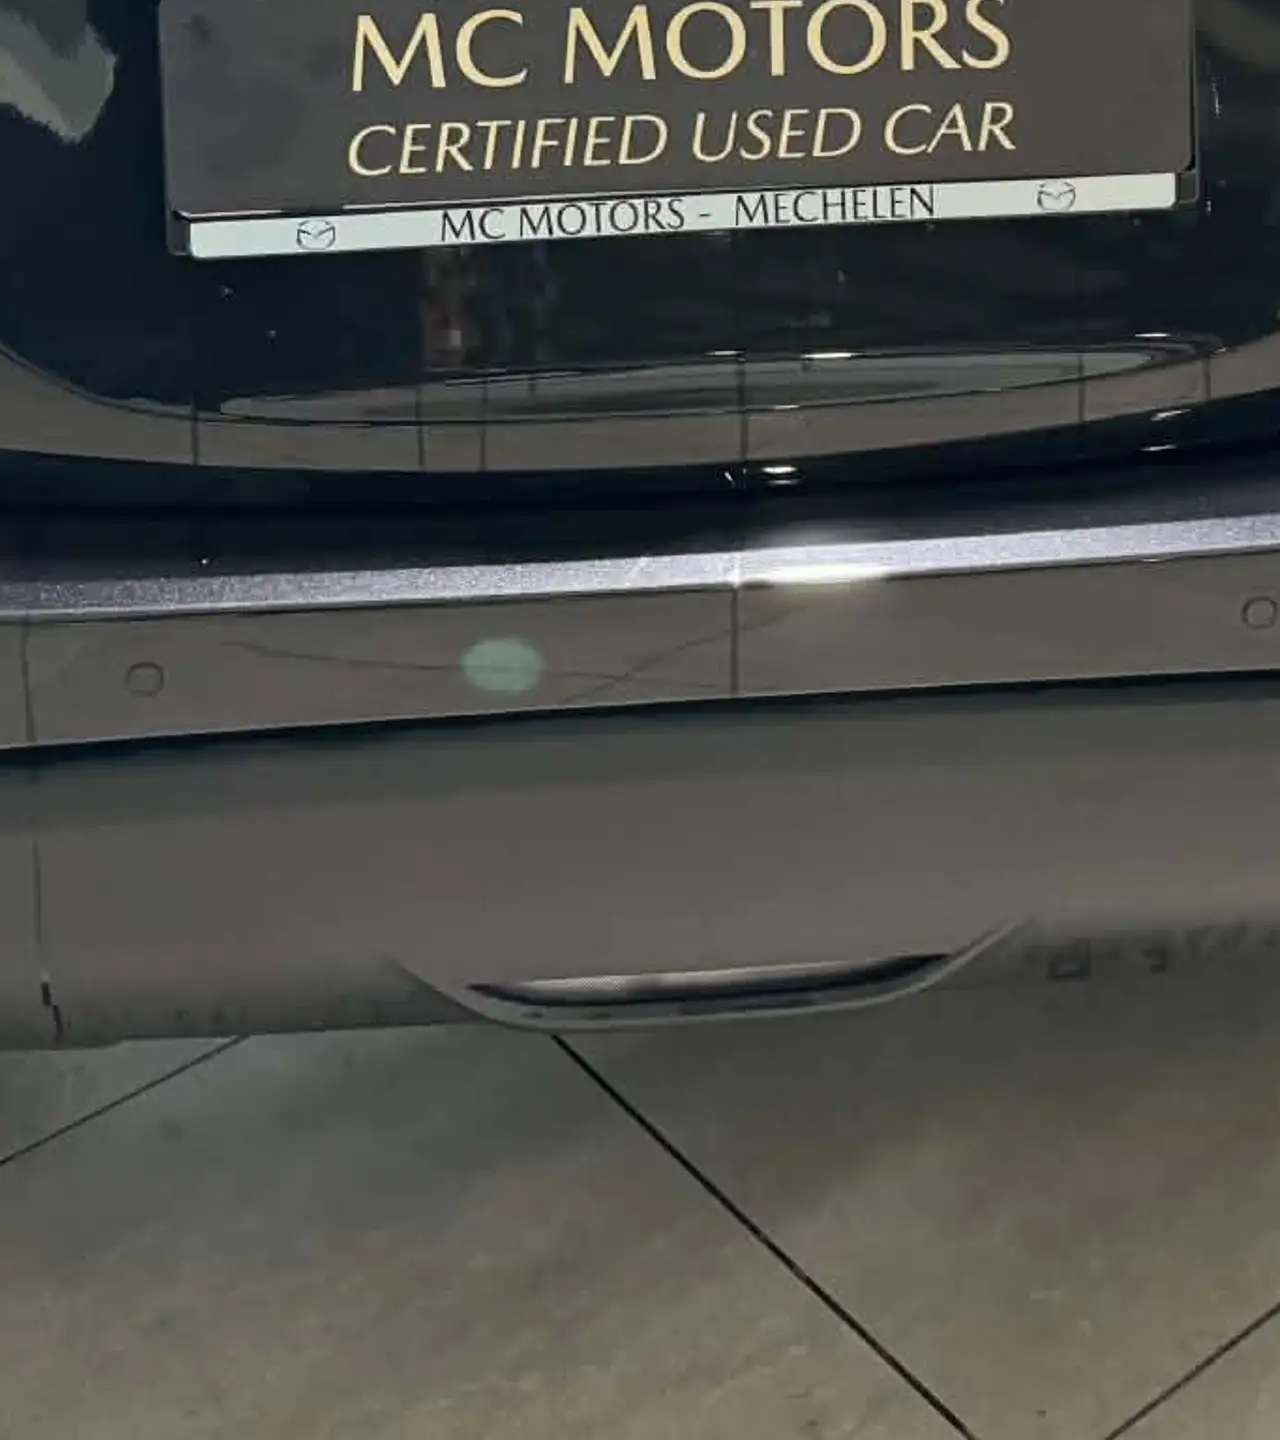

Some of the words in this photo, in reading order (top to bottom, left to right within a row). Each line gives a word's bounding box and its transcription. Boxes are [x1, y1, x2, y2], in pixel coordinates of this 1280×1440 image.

[351, 8, 528, 92] MC
[347, 113, 668, 177] CERTIFIED
[692, 107, 862, 162] USED
[883, 101, 1017, 156] CAR
[440, 208, 506, 242] MC
[518, 197, 685, 238] MOTORS
[734, 184, 935, 227] MECHELEN
